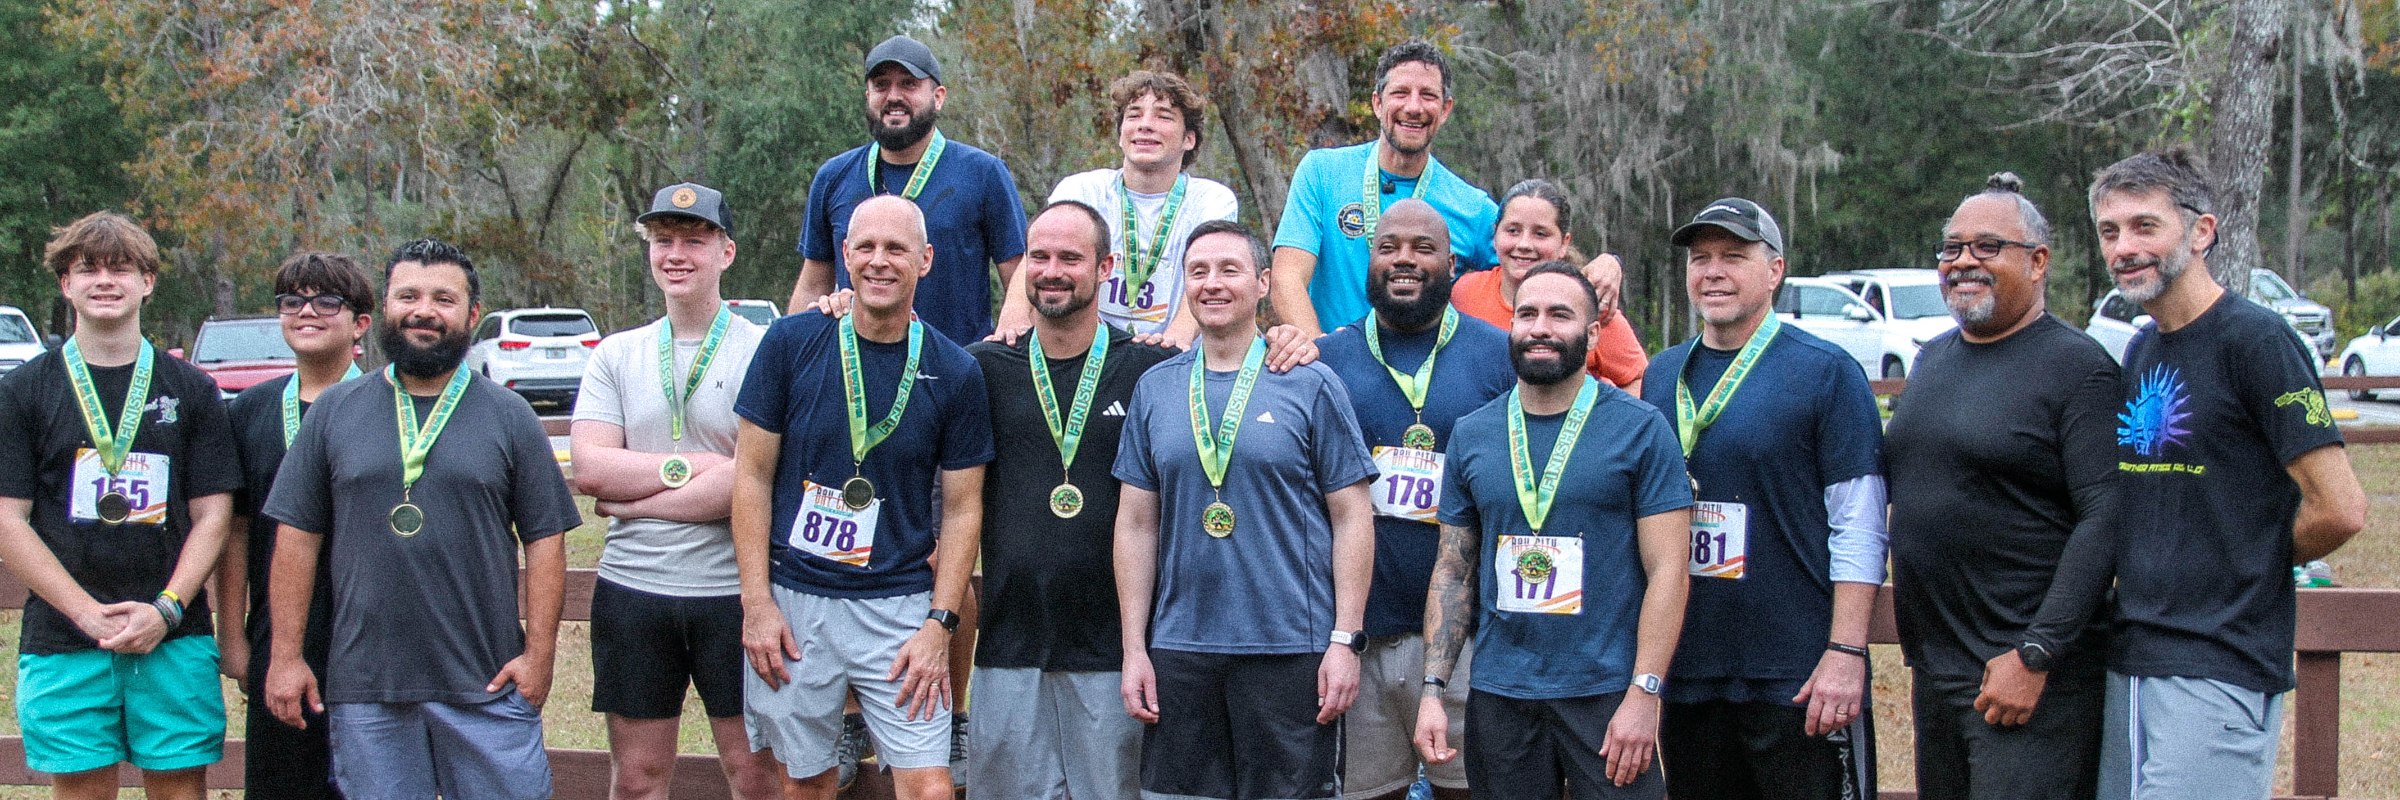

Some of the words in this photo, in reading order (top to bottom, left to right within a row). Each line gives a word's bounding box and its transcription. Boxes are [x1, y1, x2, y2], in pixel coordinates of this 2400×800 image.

[120, 367, 149, 441] FINISHER
[877, 357, 918, 436] FINISHER
[1068, 356, 1101, 437] FINISHER
[1218, 366, 1257, 447] FINISHER
[1541, 407, 1587, 492] FINISHER
[91, 477, 149, 511] 155
[1386, 474, 1434, 509] 178
[803, 511, 857, 551] 878
[1689, 530, 1726, 566] 81
